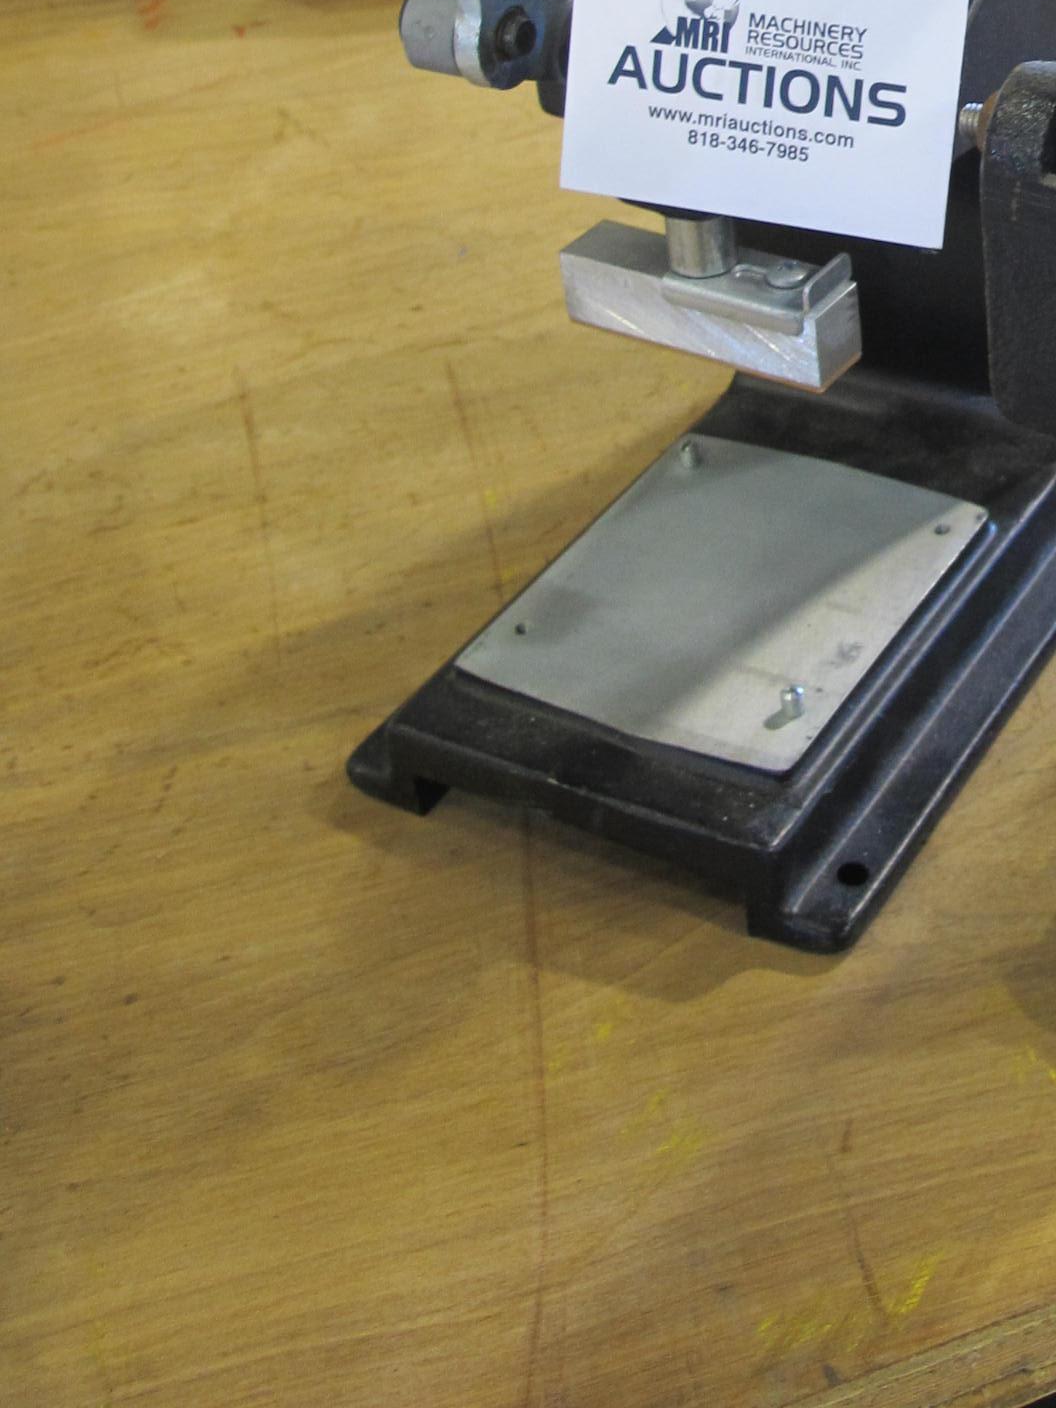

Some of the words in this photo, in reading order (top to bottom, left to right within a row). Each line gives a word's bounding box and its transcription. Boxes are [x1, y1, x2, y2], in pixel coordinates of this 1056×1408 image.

[675, 15, 730, 53] MRI
[747, 30, 864, 59] RESOURCES
[748, 12, 868, 43] MACHINERY
[607, 45, 907, 127] AUCTIONS
[648, 105, 855, 149] www.mriauctions.com
[688, 130, 809, 162] 818-346-7985
